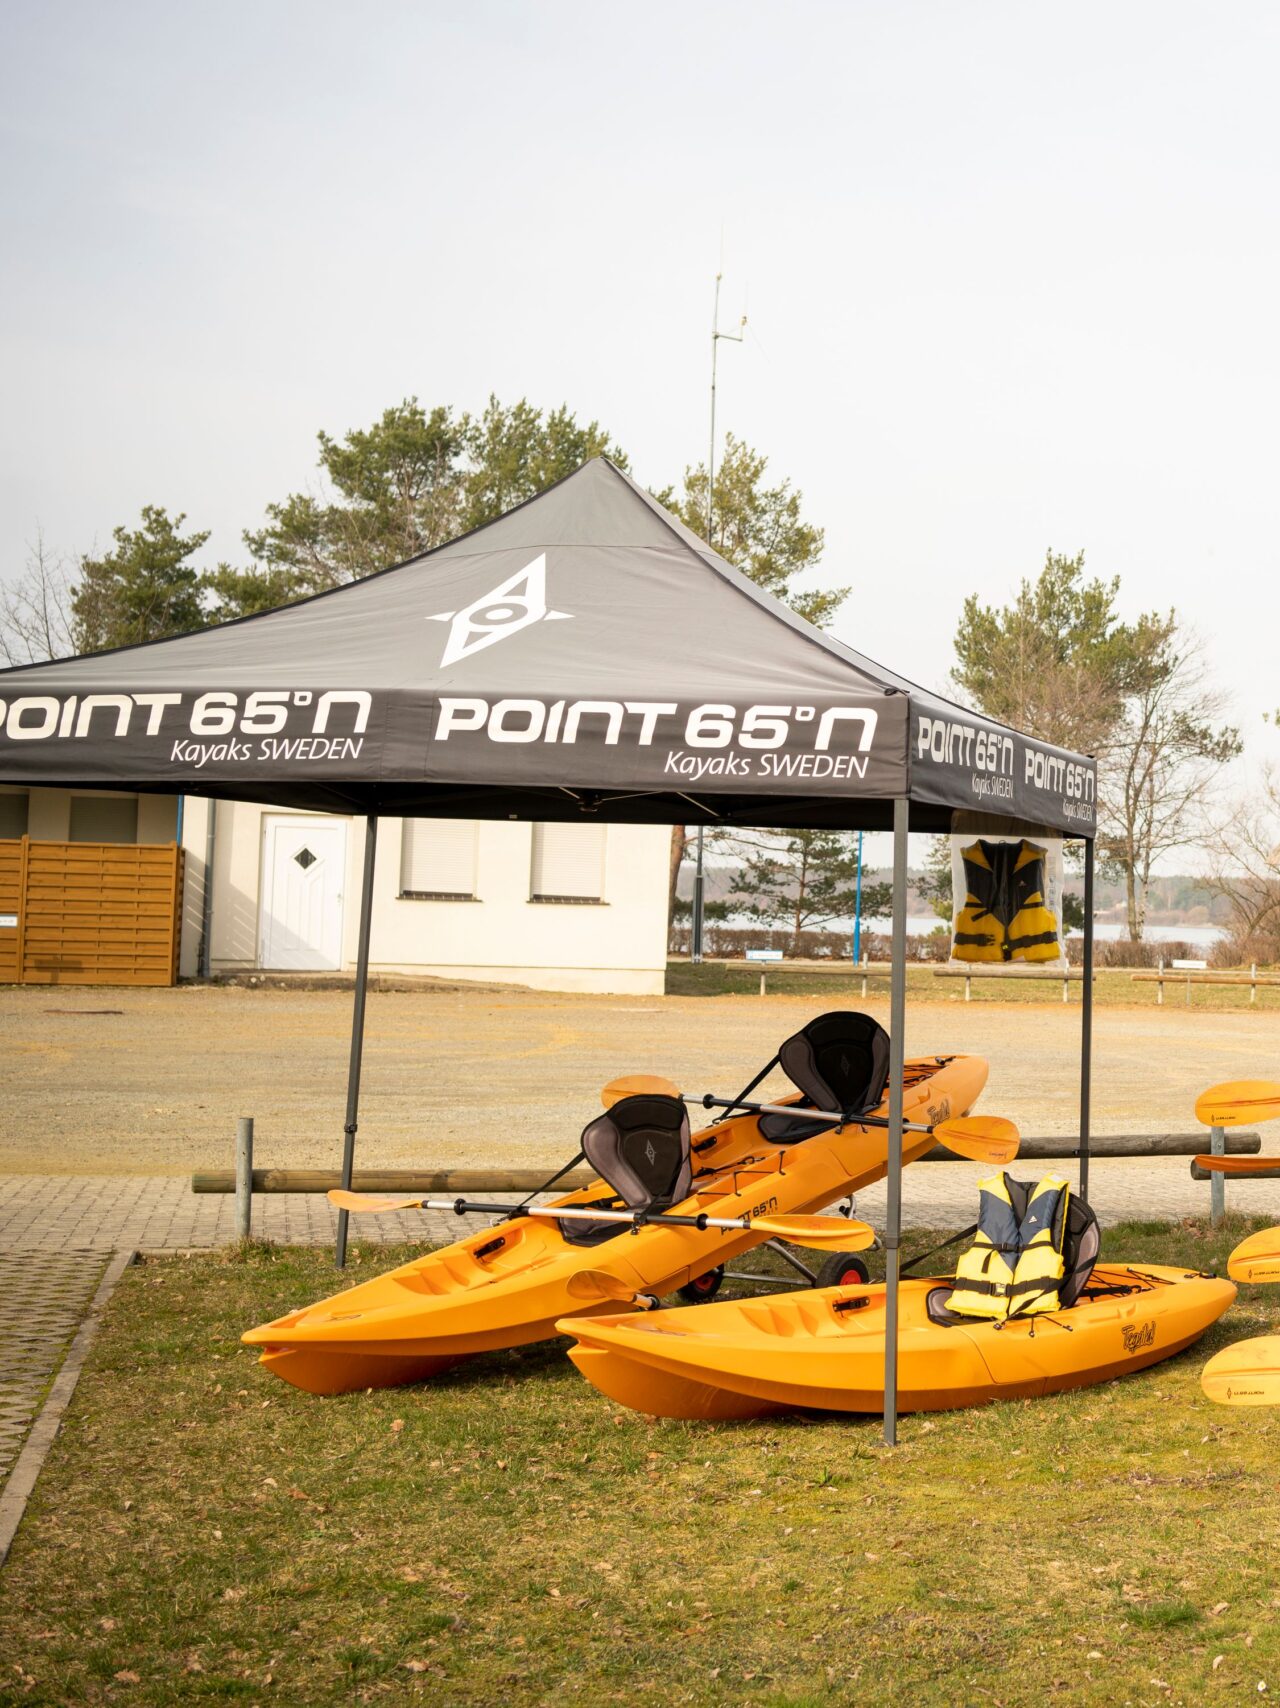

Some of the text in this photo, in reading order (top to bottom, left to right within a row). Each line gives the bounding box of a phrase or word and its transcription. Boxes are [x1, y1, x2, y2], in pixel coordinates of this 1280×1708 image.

[0, 693, 183, 740] OINT
[434, 697, 679, 746] POINT
[170, 738, 364, 768] Kayaks SWEDEN
[917, 716, 976, 767] POINT
[664, 750, 870, 781] Kayaks SWEDEN
[971, 772, 1014, 800] Kayaks SWEDEN
[1025, 748, 1067, 793] POINT
